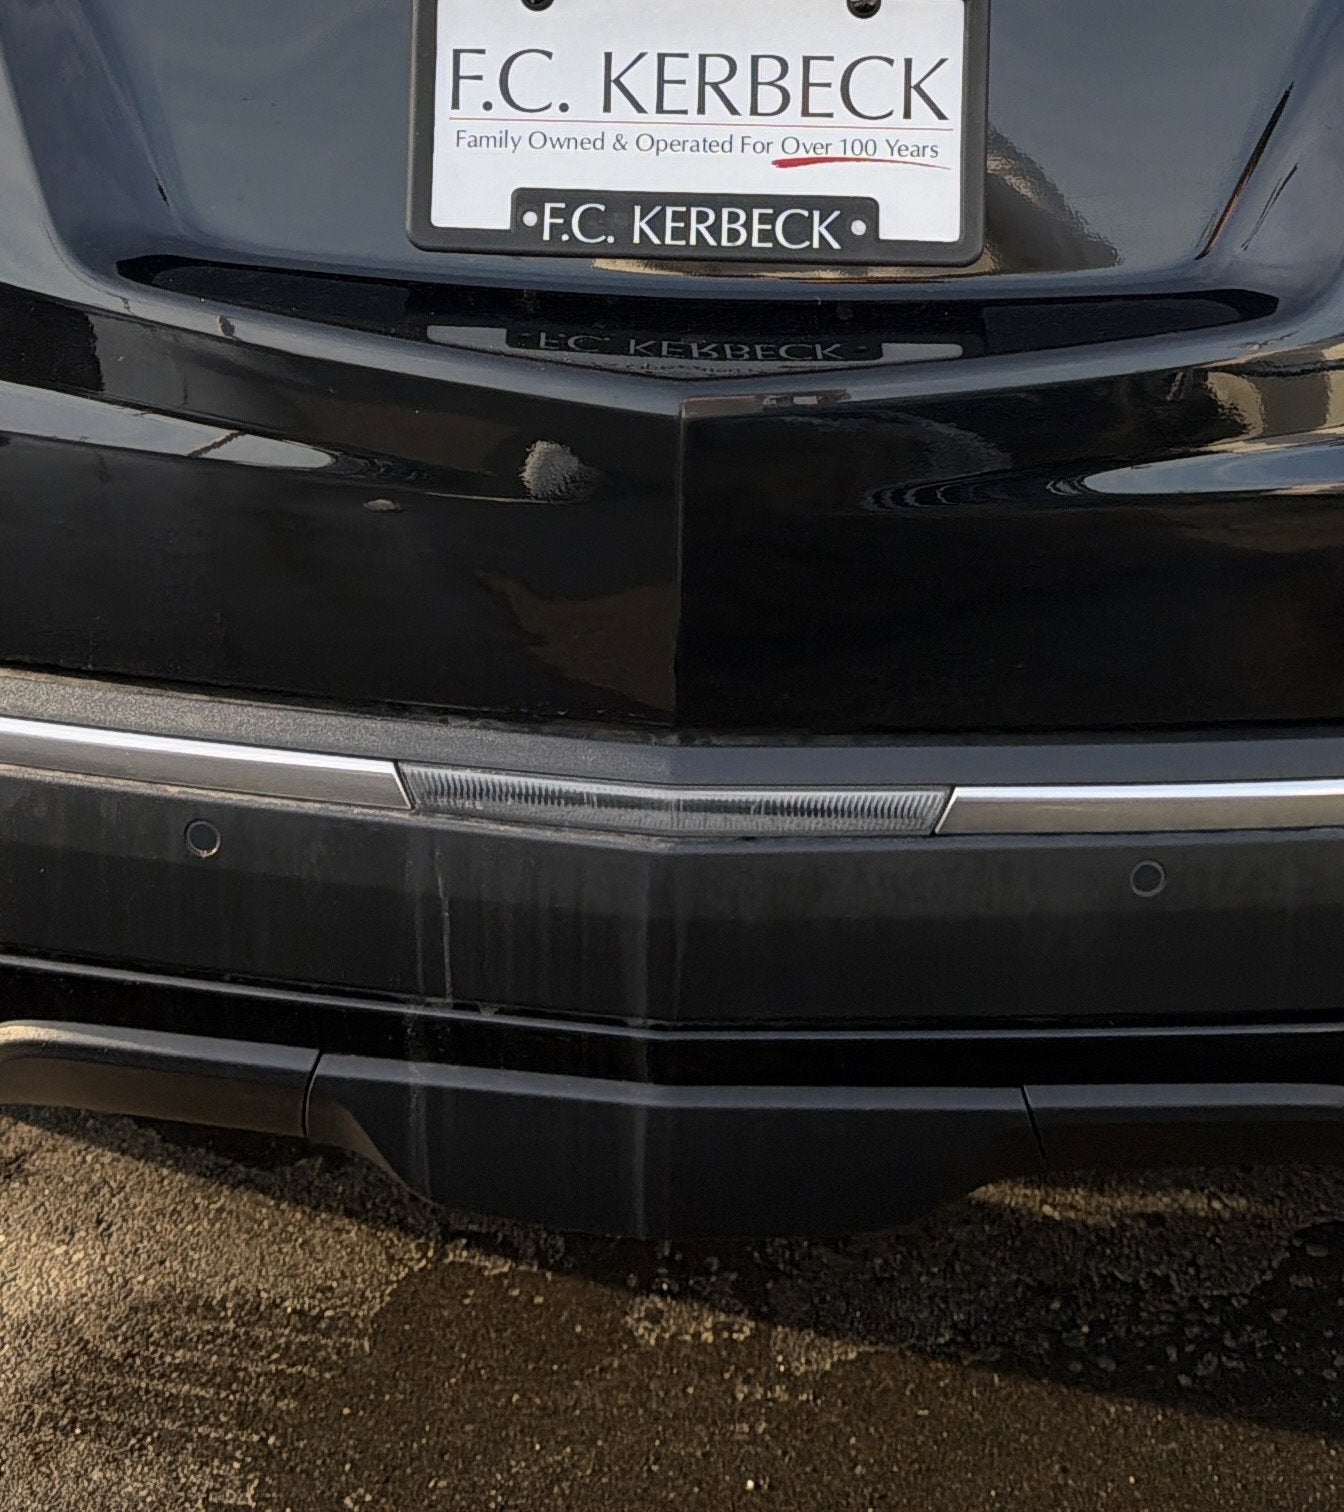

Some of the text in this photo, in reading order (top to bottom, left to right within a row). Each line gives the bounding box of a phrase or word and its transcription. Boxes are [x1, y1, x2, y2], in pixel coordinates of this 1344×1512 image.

[450, 48, 950, 122] F.C. KERBECK
[455, 129, 940, 159] Family Owned & Operated For Over 100 Years
[543, 202, 842, 251] F.C. KERBECK
